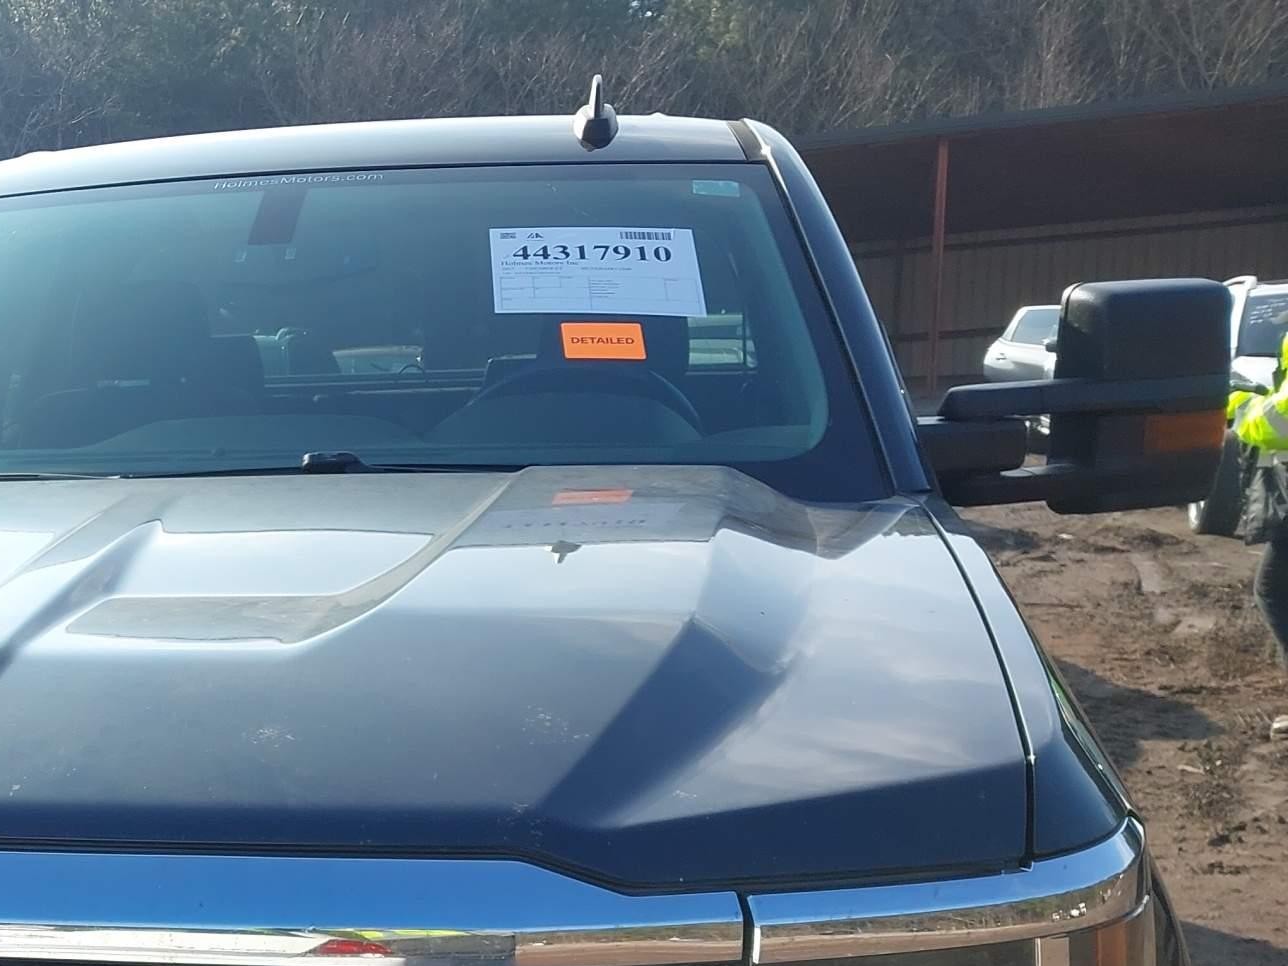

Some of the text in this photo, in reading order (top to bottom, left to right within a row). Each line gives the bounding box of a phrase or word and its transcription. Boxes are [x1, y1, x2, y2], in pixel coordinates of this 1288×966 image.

[214, 173, 384, 190] HolmesMotors.com
[512, 244, 672, 262] 44317910
[570, 336, 635, 345] DETAILED
